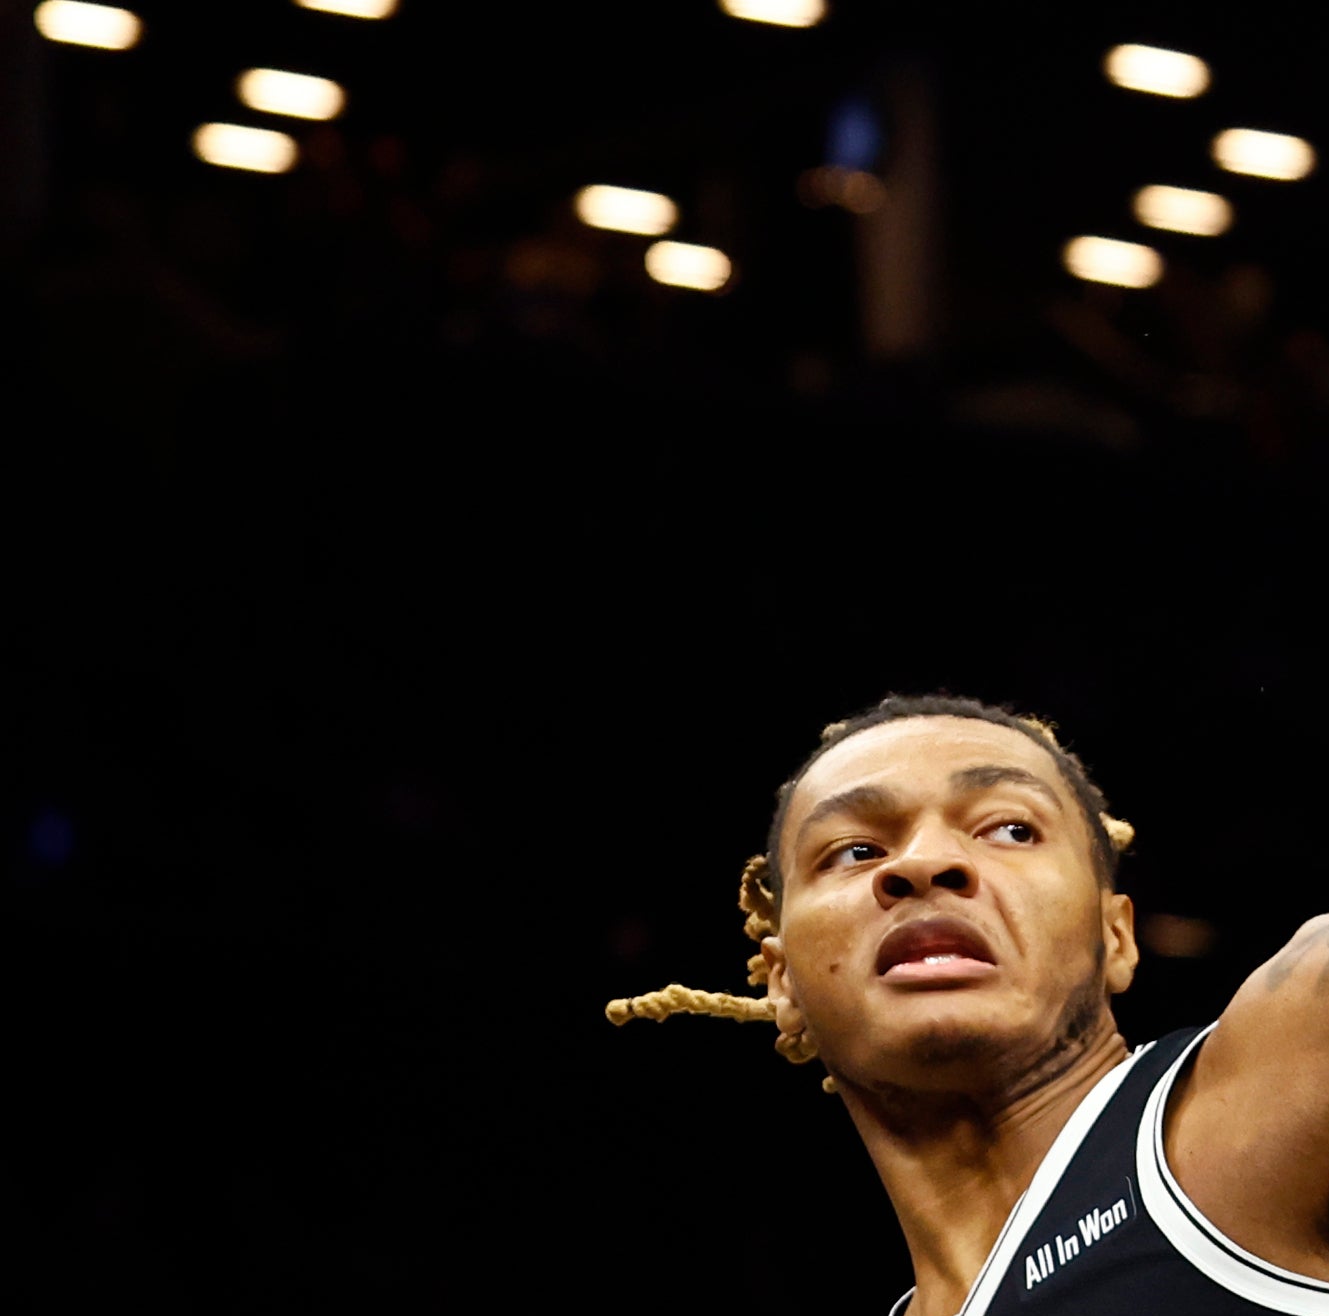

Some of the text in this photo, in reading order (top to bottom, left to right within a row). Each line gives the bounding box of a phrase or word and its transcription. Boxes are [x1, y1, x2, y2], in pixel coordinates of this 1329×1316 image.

[1025, 1198, 1128, 1290] All In Won
